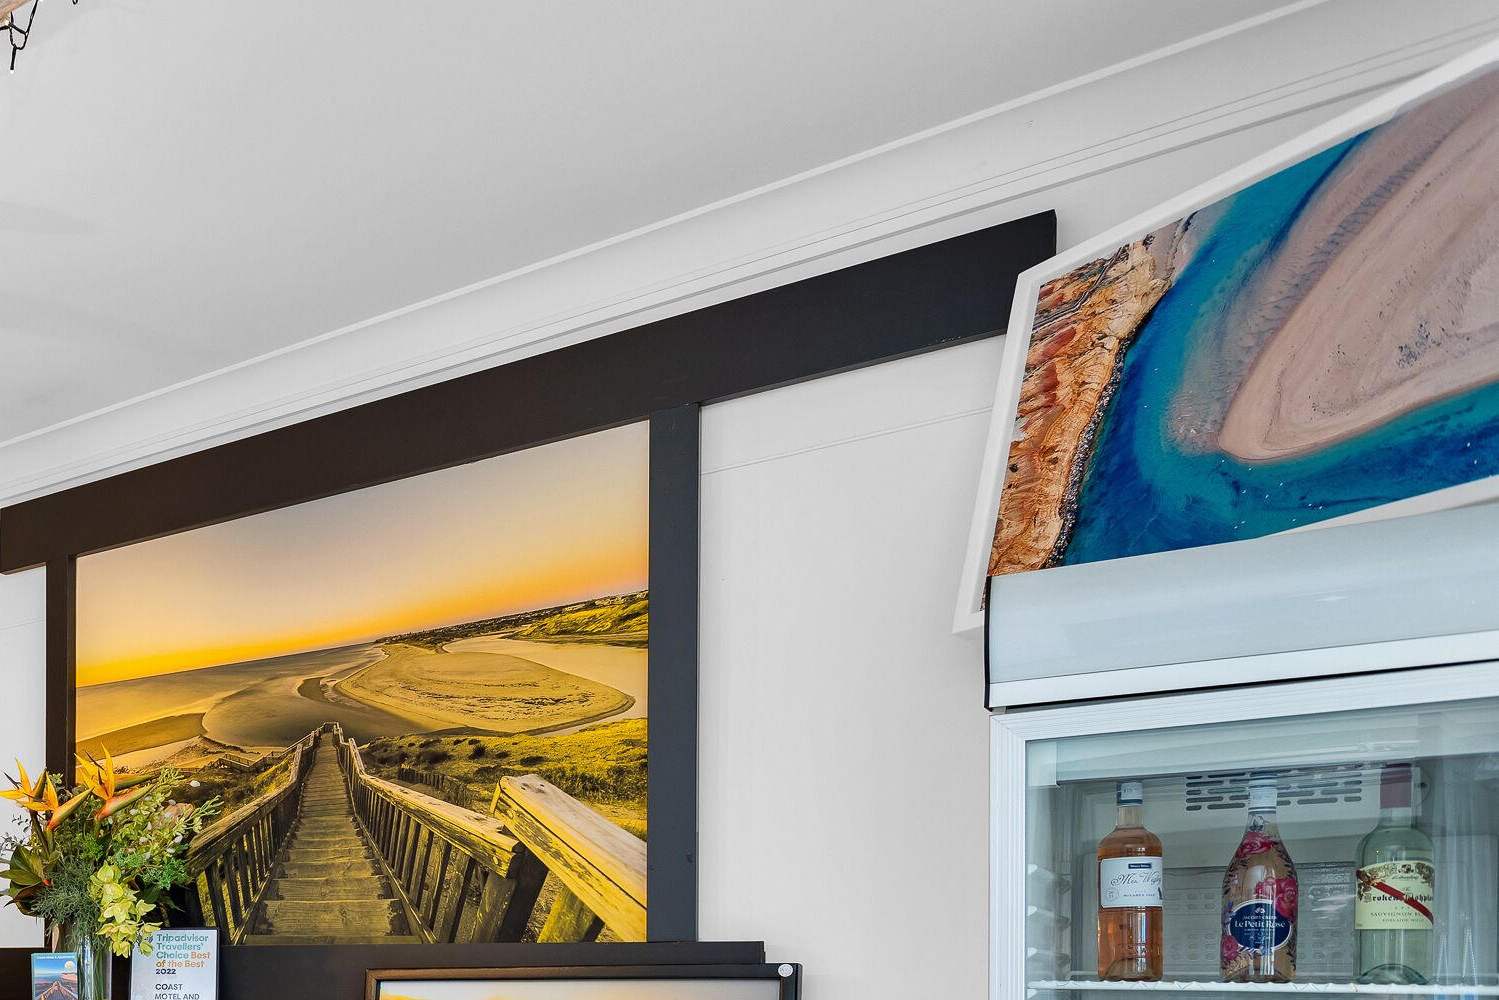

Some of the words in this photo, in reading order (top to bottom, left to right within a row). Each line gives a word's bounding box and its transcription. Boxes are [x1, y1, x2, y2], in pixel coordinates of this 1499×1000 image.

[157, 934, 208, 942] Tripadvisor
[156, 951, 189, 959] Choice
[190, 951, 211, 959] Best
[184, 960, 205, 968] Best
